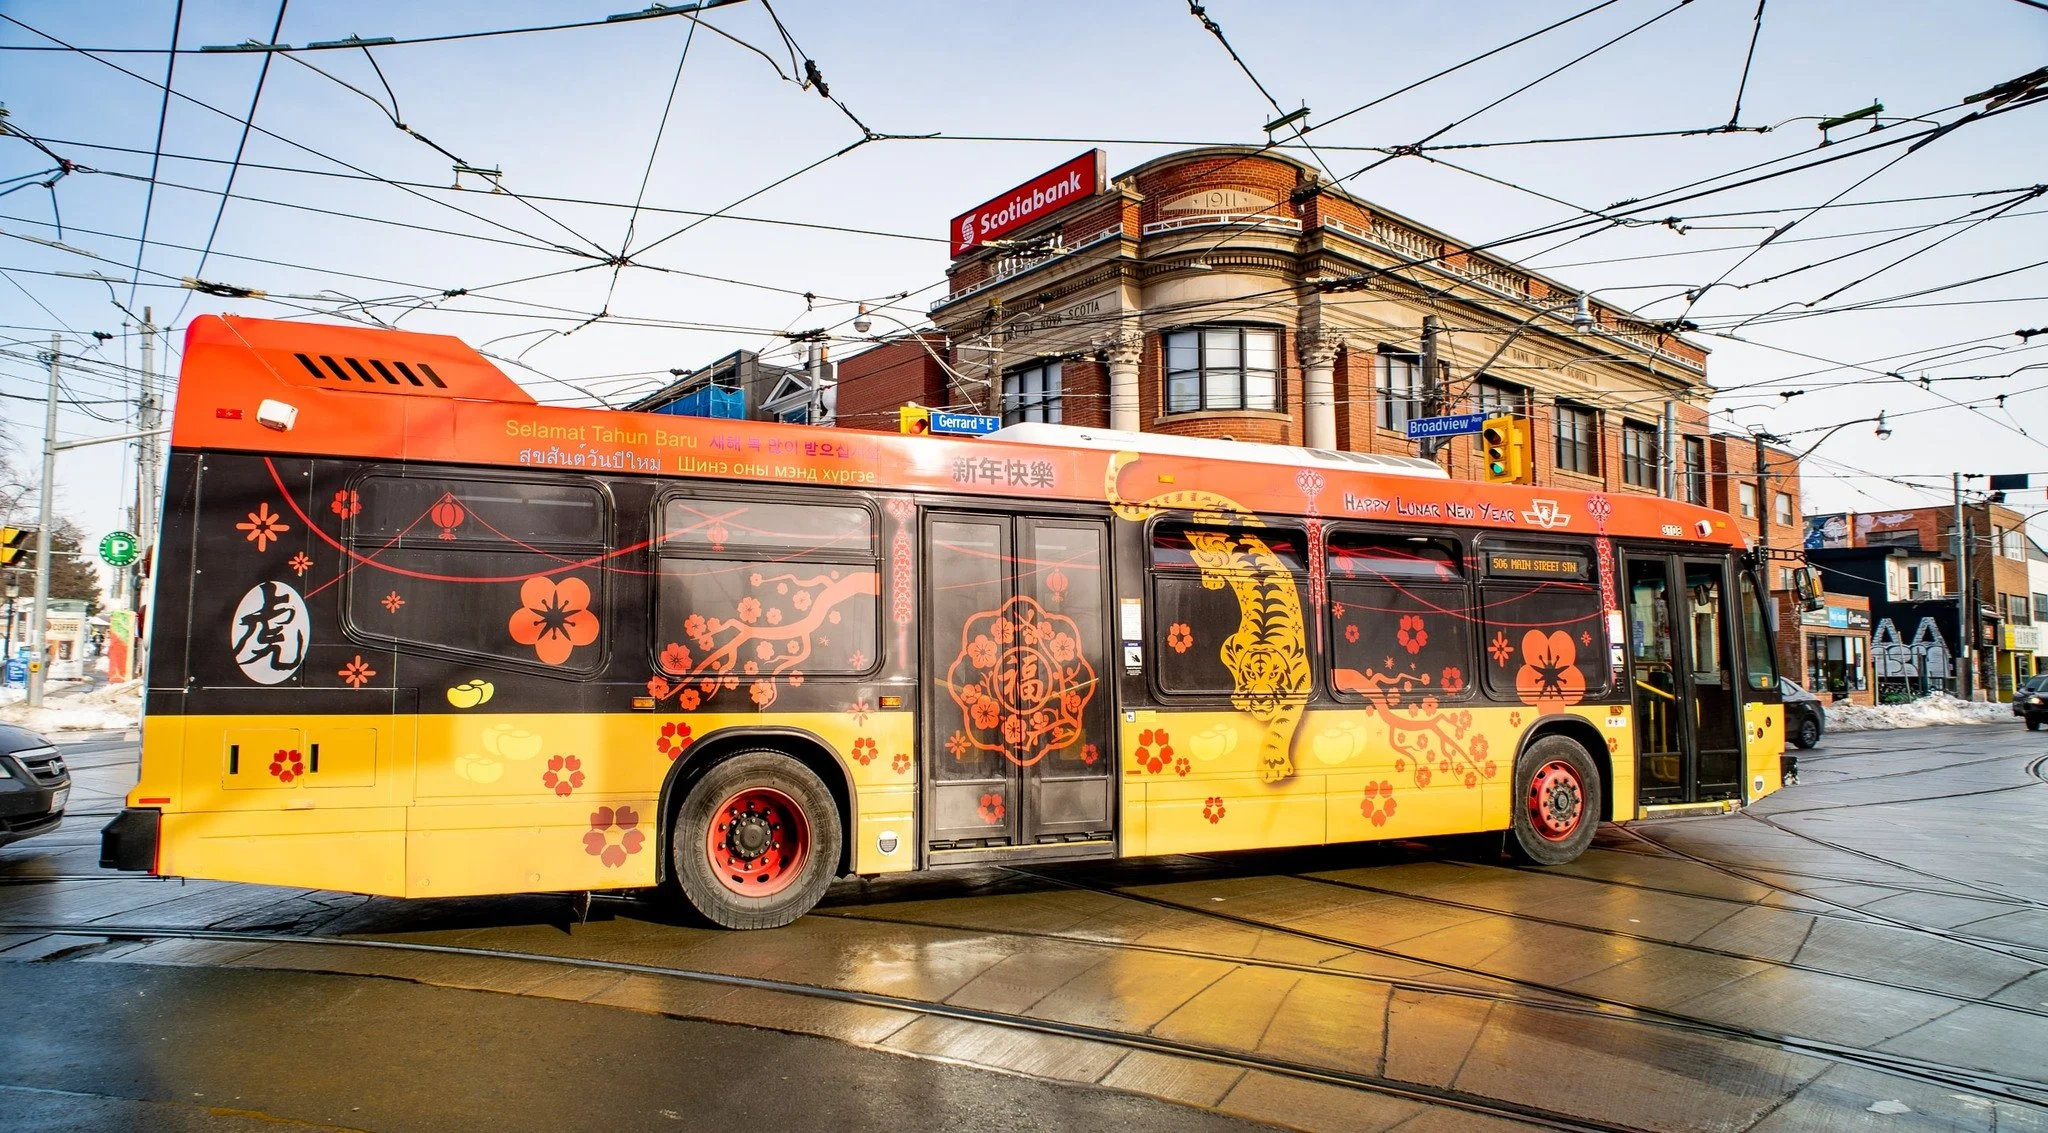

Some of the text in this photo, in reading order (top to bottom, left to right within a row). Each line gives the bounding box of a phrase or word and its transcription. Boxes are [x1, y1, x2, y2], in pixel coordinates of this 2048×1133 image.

[981, 170, 1081, 235] Scotiabank
[1205, 192, 1236, 208] 1911
[1068, 301, 1100, 318] SCOTIA
[939, 415, 977, 430] Gerrard
[987, 418, 993, 430] E
[1410, 418, 1468, 433] Broadview
[506, 419, 697, 449] Selamat Tahun Baru
[709, 433, 741, 452] 새해
[768, 437, 798, 456] 많이
[677, 455, 728, 475] Шинэ
[733, 463, 769, 476] оны
[774, 465, 818, 481] мэнд
[952, 457, 1055, 488] 新年快樂
[112, 540, 129, 556] P
[1493, 558, 1577, 573] 506 MAIN STREET STN
[53, 623, 79, 632] COFFEE
[998, 654, 1044, 705] 福
